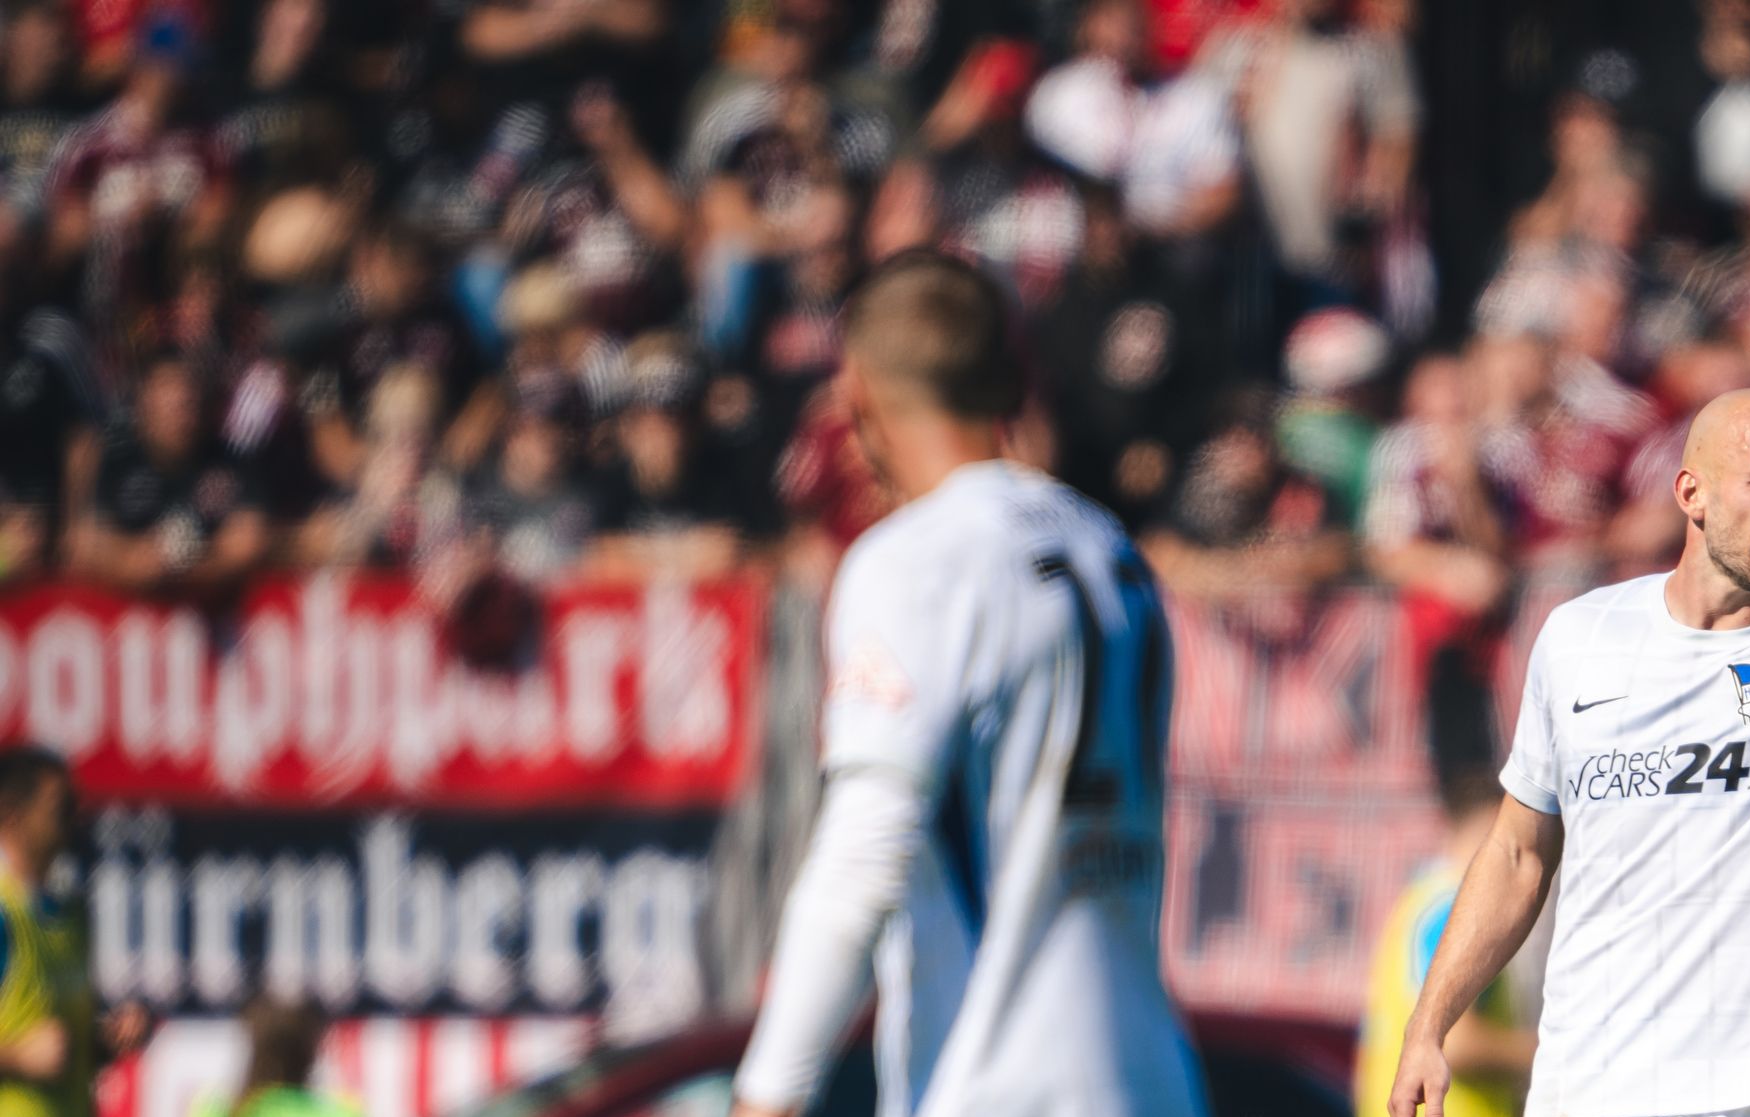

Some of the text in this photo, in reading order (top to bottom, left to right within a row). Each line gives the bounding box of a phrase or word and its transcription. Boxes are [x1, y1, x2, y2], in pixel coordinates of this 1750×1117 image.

[1596, 744, 1675, 775] check
[1587, 770, 1663, 801] CARS
[50, 808, 708, 1045] ürnberg
